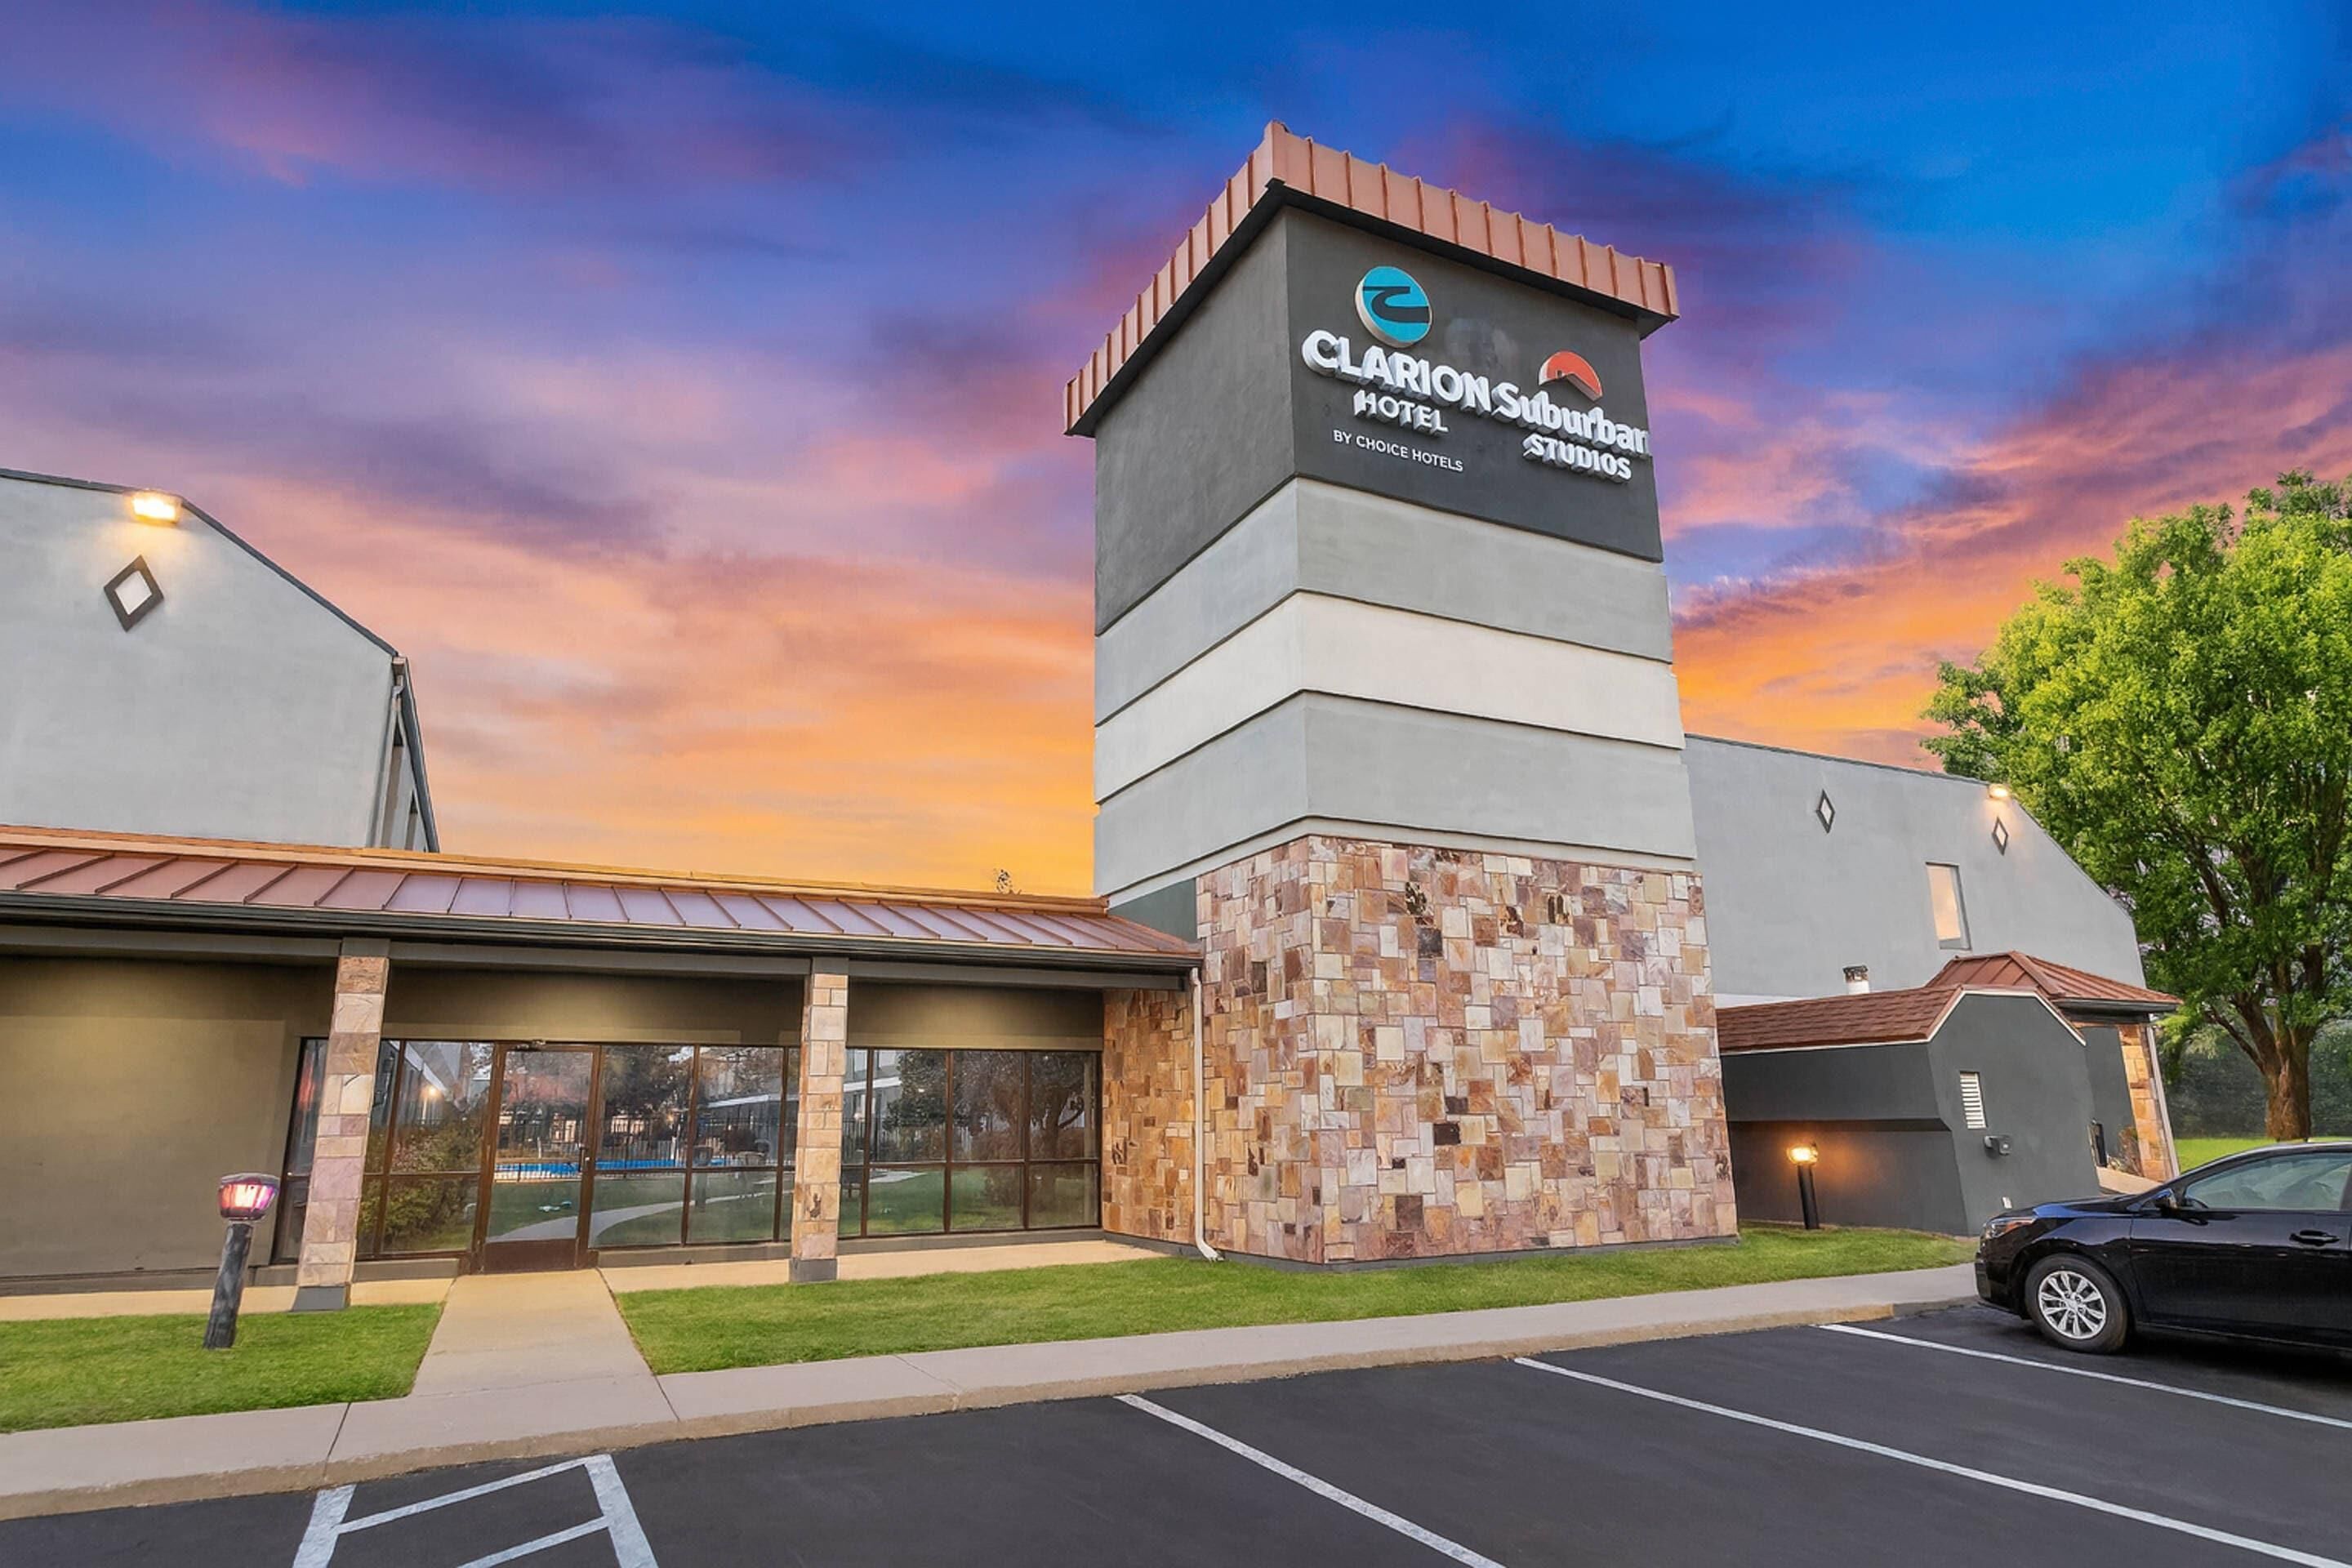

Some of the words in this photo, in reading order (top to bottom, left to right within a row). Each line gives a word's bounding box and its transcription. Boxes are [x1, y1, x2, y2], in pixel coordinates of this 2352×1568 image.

[1302, 330, 1492, 416] CLARION
[1353, 390, 1449, 436] HOTEL
[1491, 382, 1650, 458] Suburban
[1333, 430, 1352, 445] BY
[1356, 434, 1409, 459] CHOICE
[1412, 448, 1463, 473] HOTELS
[1522, 433, 1632, 482] STUDIOS
